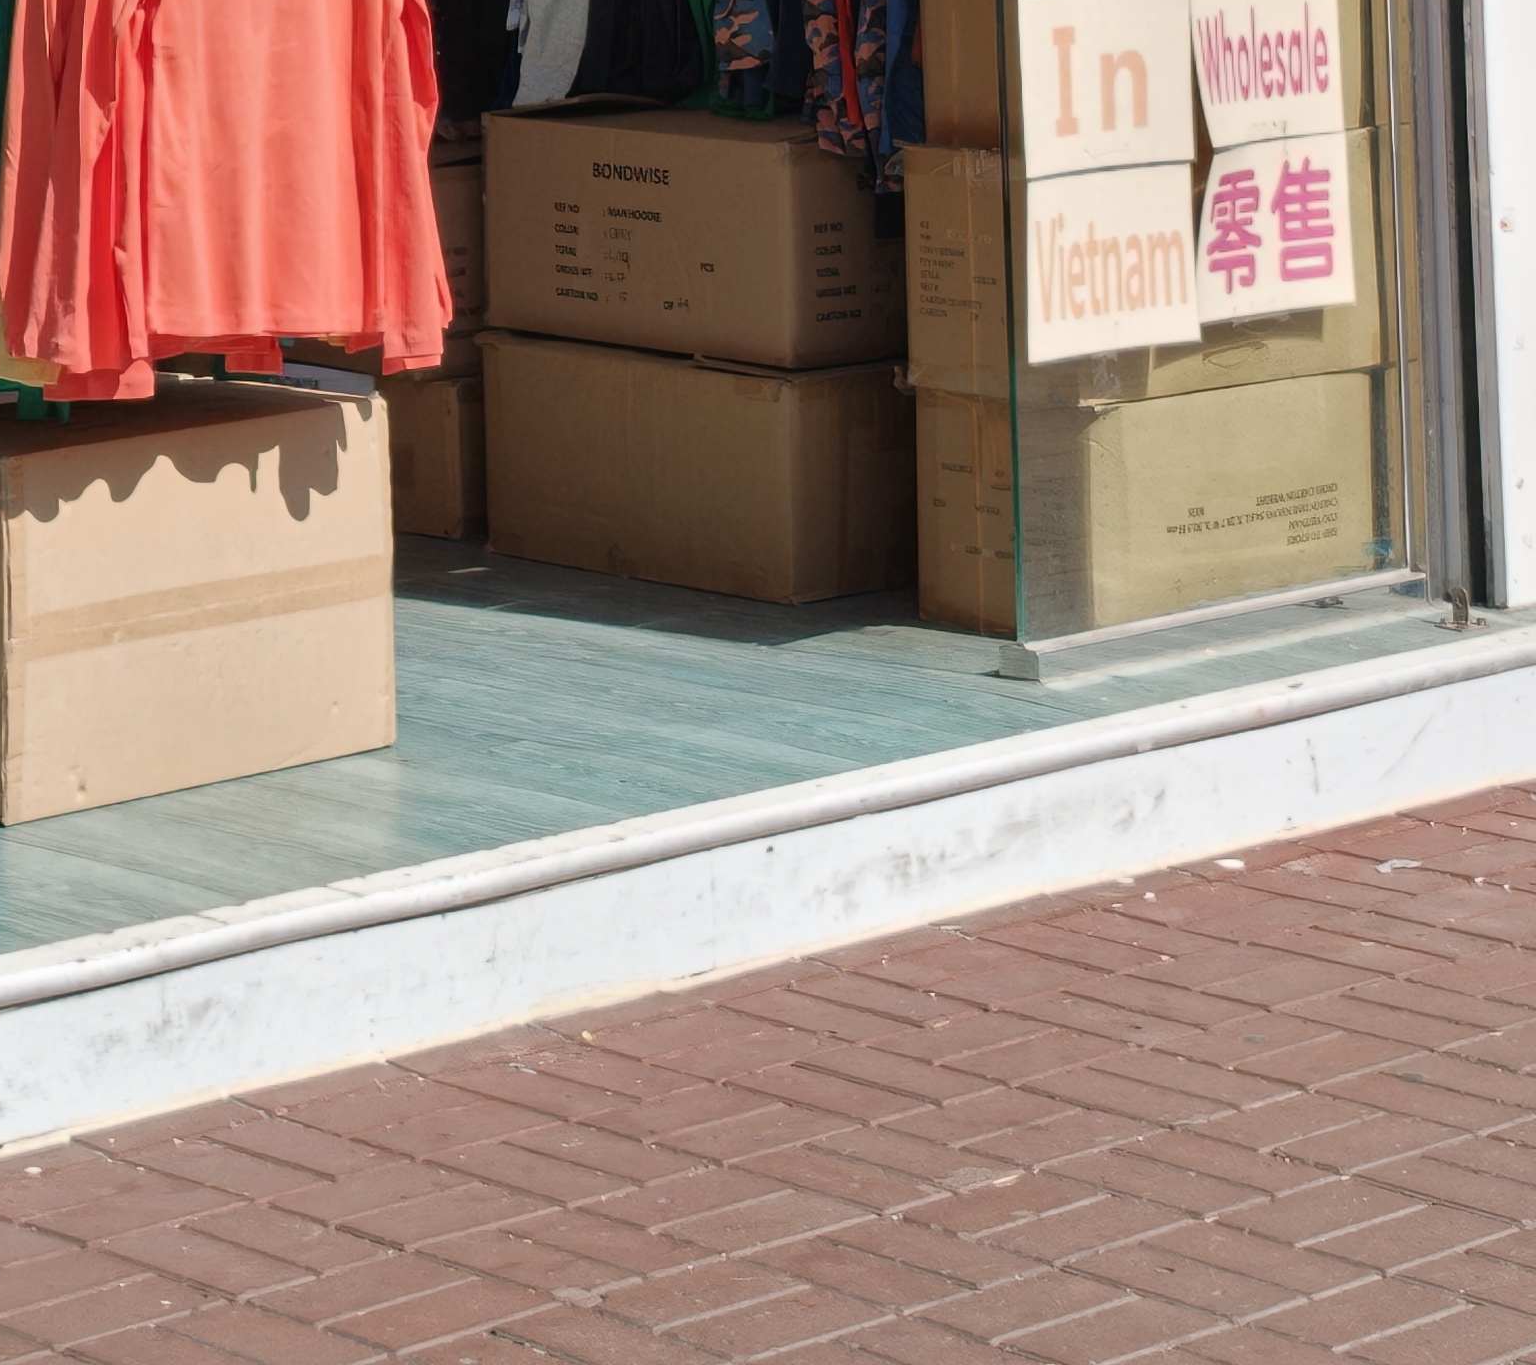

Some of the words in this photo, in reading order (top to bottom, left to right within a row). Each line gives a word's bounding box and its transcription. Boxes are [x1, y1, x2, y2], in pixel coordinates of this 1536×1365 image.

[1051, 25, 1149, 138] In
[1196, 0, 1329, 107] Wholesale
[592, 162, 670, 187] BONDWISE
[1206, 155, 1335, 295] 零售
[1035, 212, 1189, 324] Vietnam
